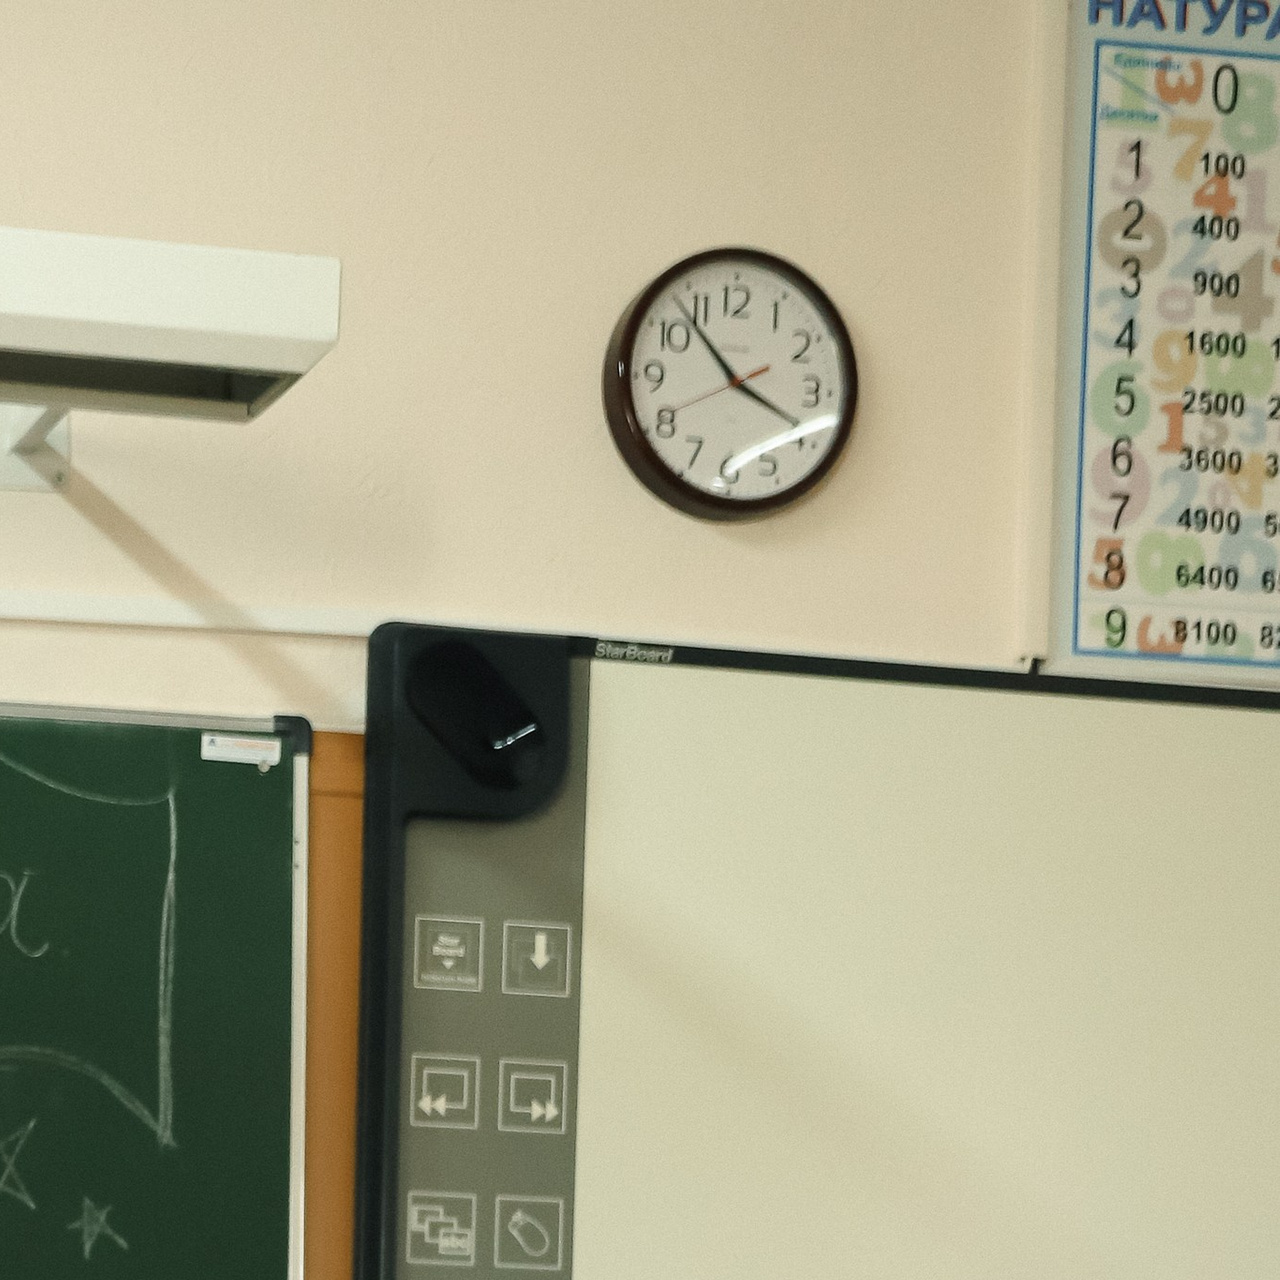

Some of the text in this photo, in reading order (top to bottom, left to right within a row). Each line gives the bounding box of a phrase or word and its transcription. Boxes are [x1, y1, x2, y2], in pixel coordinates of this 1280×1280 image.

[1213, 63, 1239, 115] 0
[1128, 139, 1246, 180] 1 100
[1122, 200, 1240, 241] 2 400
[1120, 256, 1240, 298] 3 900
[693, 292, 709, 327] 11
[722, 285, 751, 319] 12
[772, 300, 780, 333] 1
[659, 318, 690, 353] 10
[791, 328, 811, 363] 2
[1114, 318, 1136, 355] 4
[1185, 331, 1247, 358] 1600
[644, 359, 665, 393] 9
[801, 373, 820, 408] 3
[1114, 375, 1136, 416] 5
[1182, 388, 1245, 417] 2500
[656, 407, 675, 438] 8
[685, 434, 704, 469] 7
[1111, 437, 1133, 476] 6
[1179, 445, 1243, 475] 3600
[1109, 493, 1130, 531] 7
[1177, 507, 1242, 535] 4900
[1104, 551, 1126, 590] 8
[1176, 563, 1239, 591] 6400
[1106, 608, 1126, 647] 9
[1174, 619, 1237, 646] 8100
[595, 642, 675, 664] StarBoard
